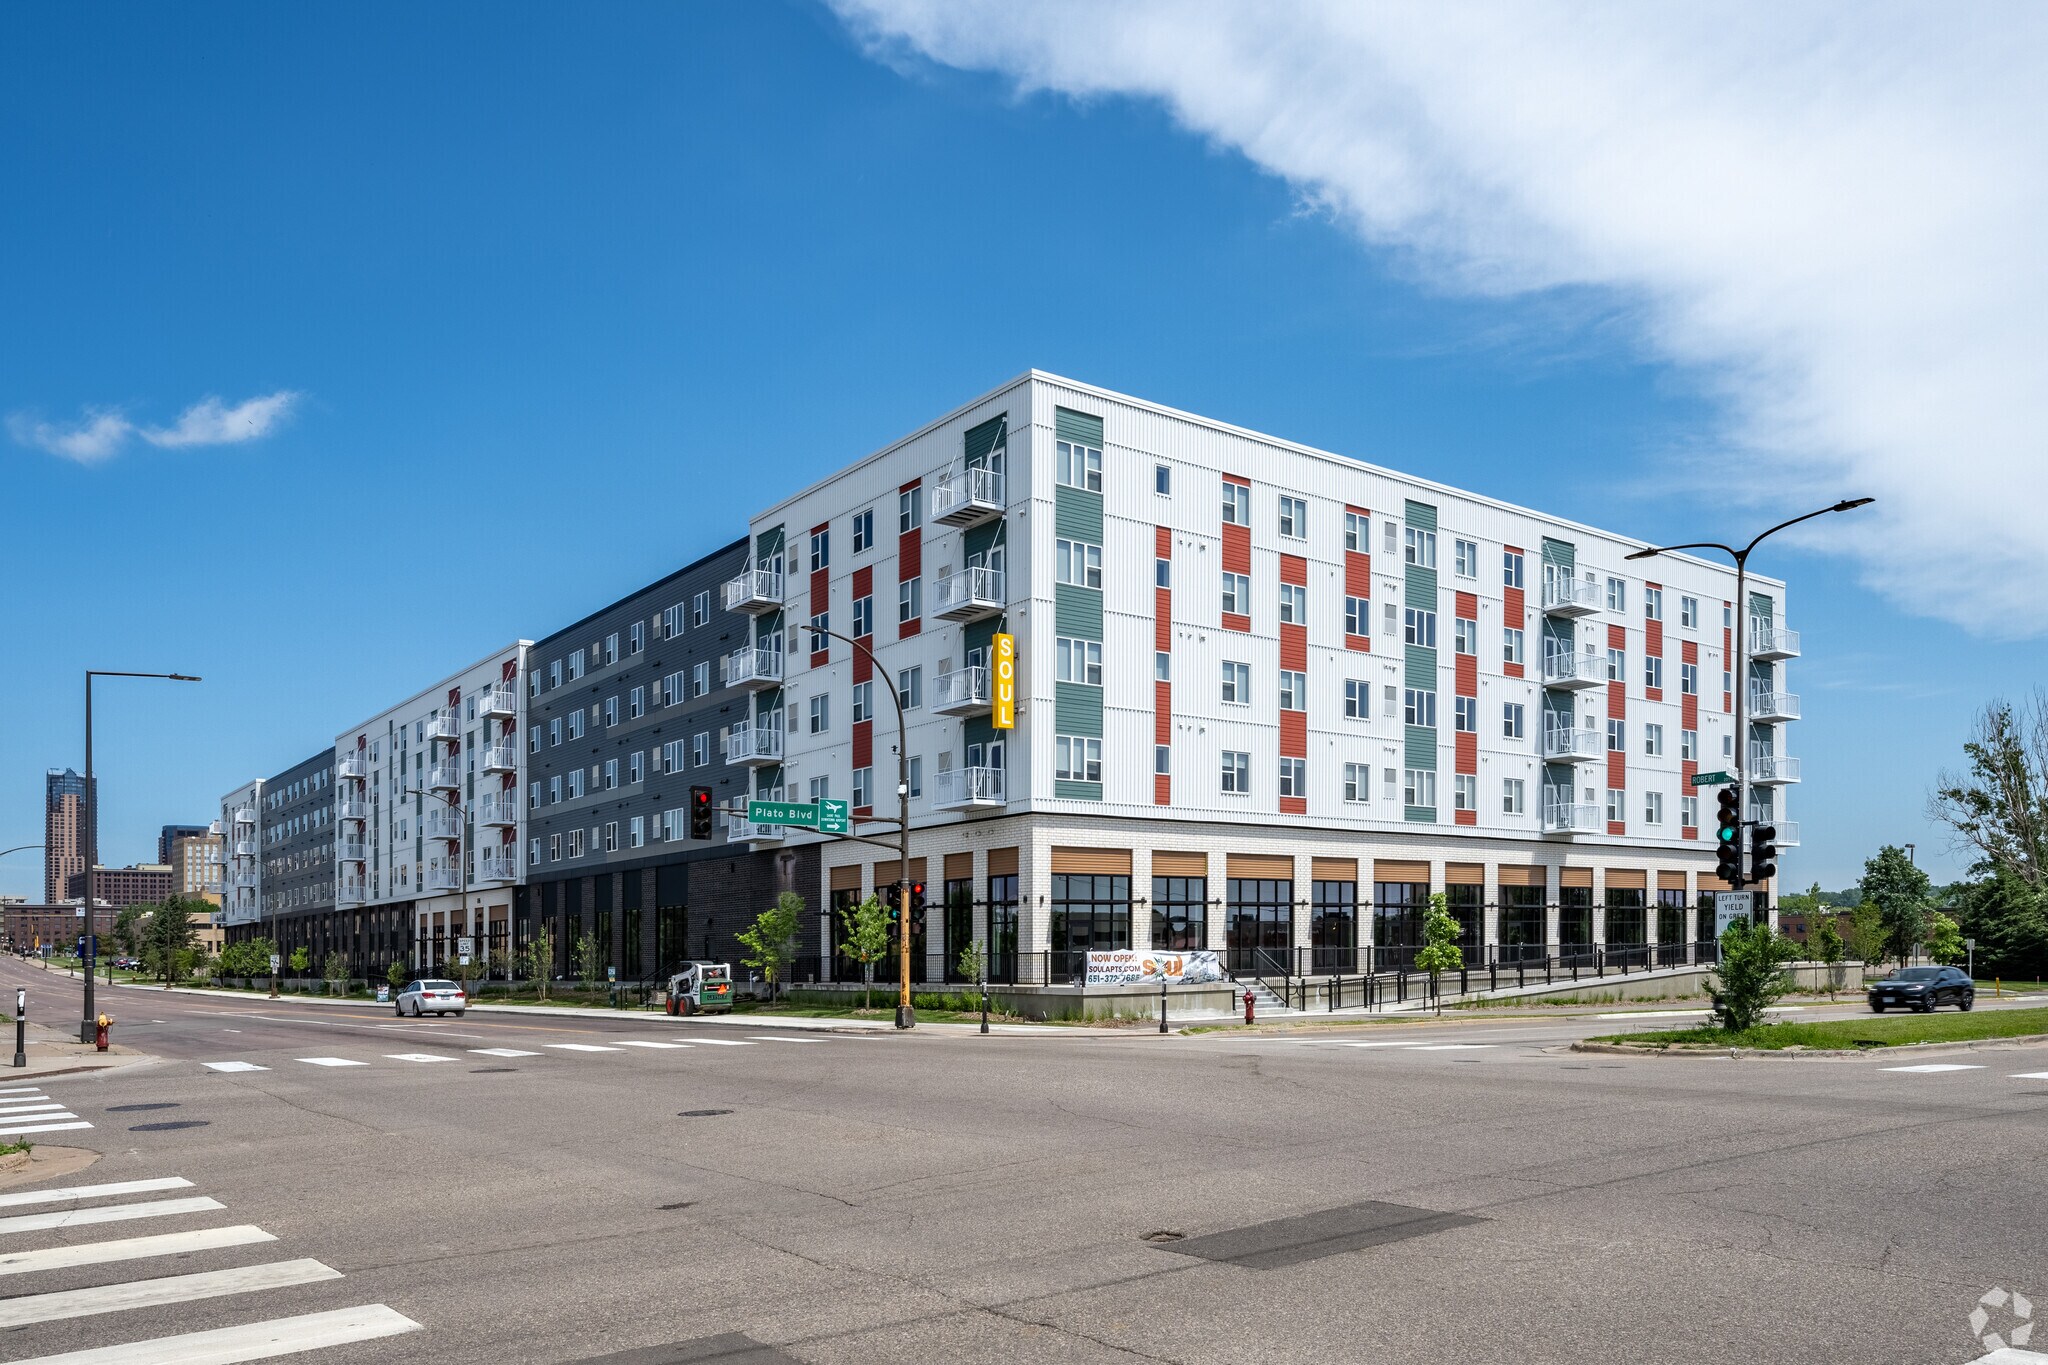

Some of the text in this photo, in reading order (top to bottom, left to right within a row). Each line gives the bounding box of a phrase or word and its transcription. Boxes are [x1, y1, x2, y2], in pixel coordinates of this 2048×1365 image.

[1000, 638, 1012, 725] SOUL
[1692, 775, 1716, 785] ROBERT
[755, 807, 813, 820] Plato Blvd
[1723, 903, 1744, 911] YIELD
[1091, 954, 1112, 963] NOW
[1088, 965, 1141, 973] SOULAPTS.COM
